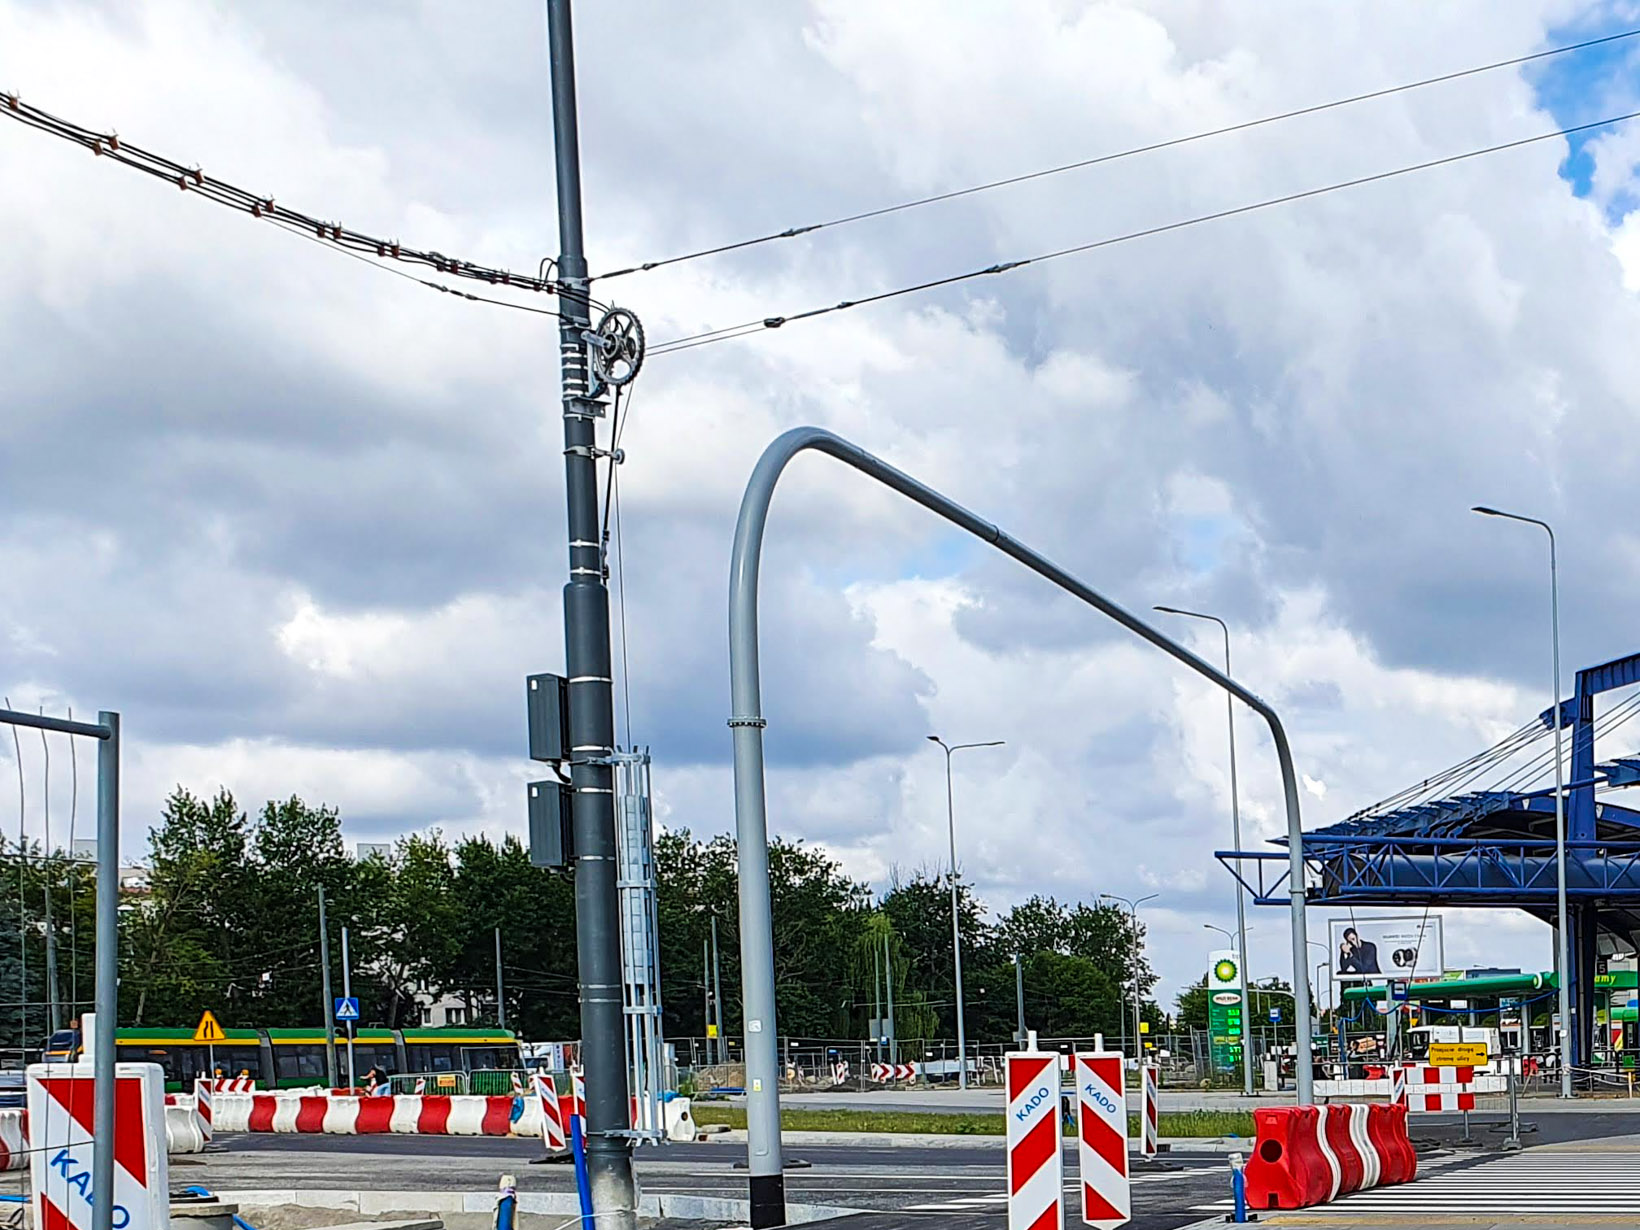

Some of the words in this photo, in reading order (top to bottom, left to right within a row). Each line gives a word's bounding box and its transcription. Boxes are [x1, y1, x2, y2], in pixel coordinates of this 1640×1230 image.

[1594, 974, 1616, 985] amy
[1015, 1087, 1050, 1122] KADO
[1084, 1083, 1117, 1114] KADO
